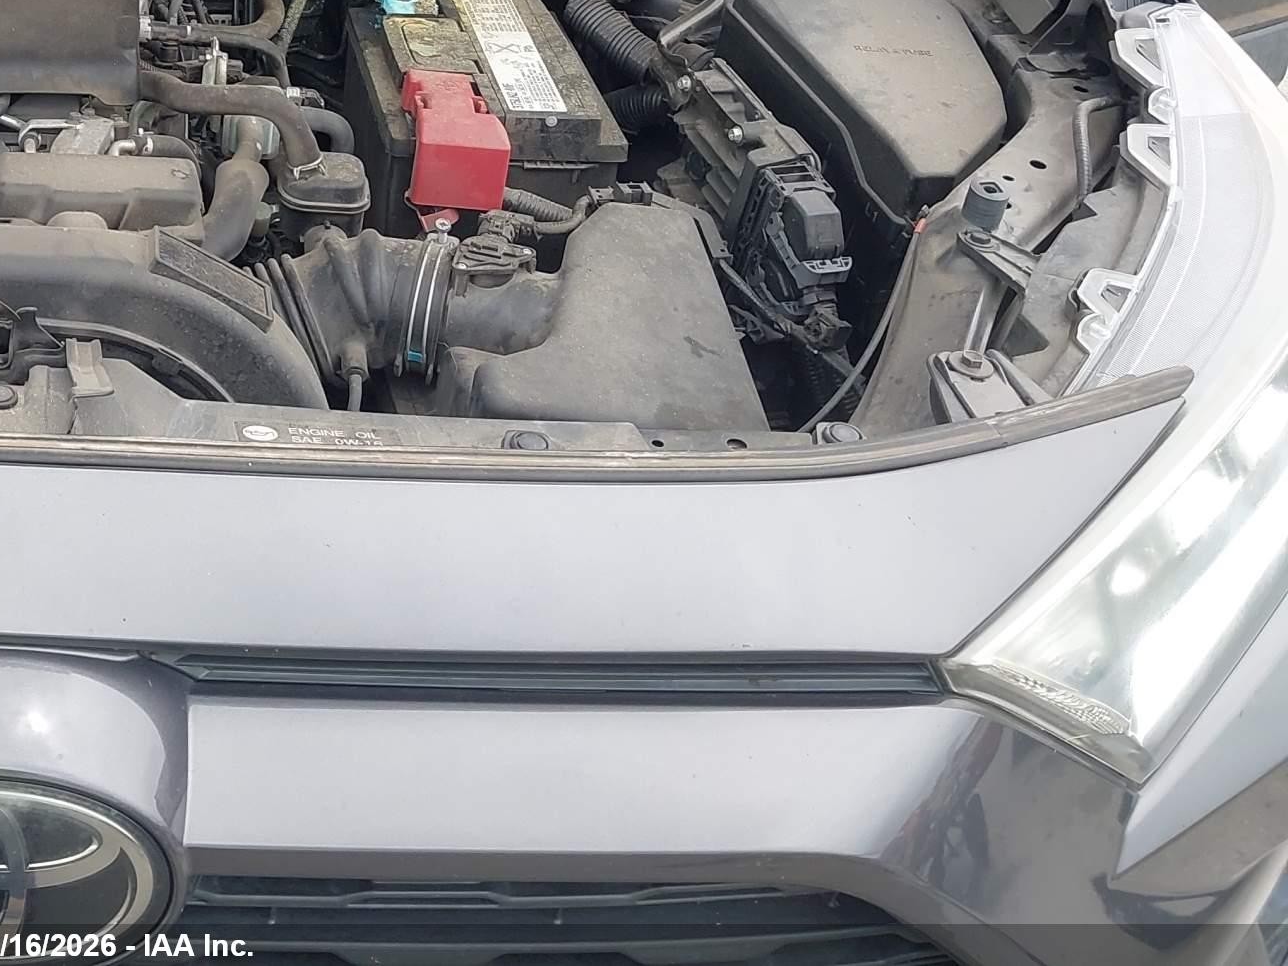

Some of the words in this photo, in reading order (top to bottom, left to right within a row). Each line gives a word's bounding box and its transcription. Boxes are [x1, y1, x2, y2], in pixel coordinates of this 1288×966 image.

[288, 427, 345, 438] ENGINE
[354, 431, 382, 440] OIL
[291, 436, 323, 444] SAE
